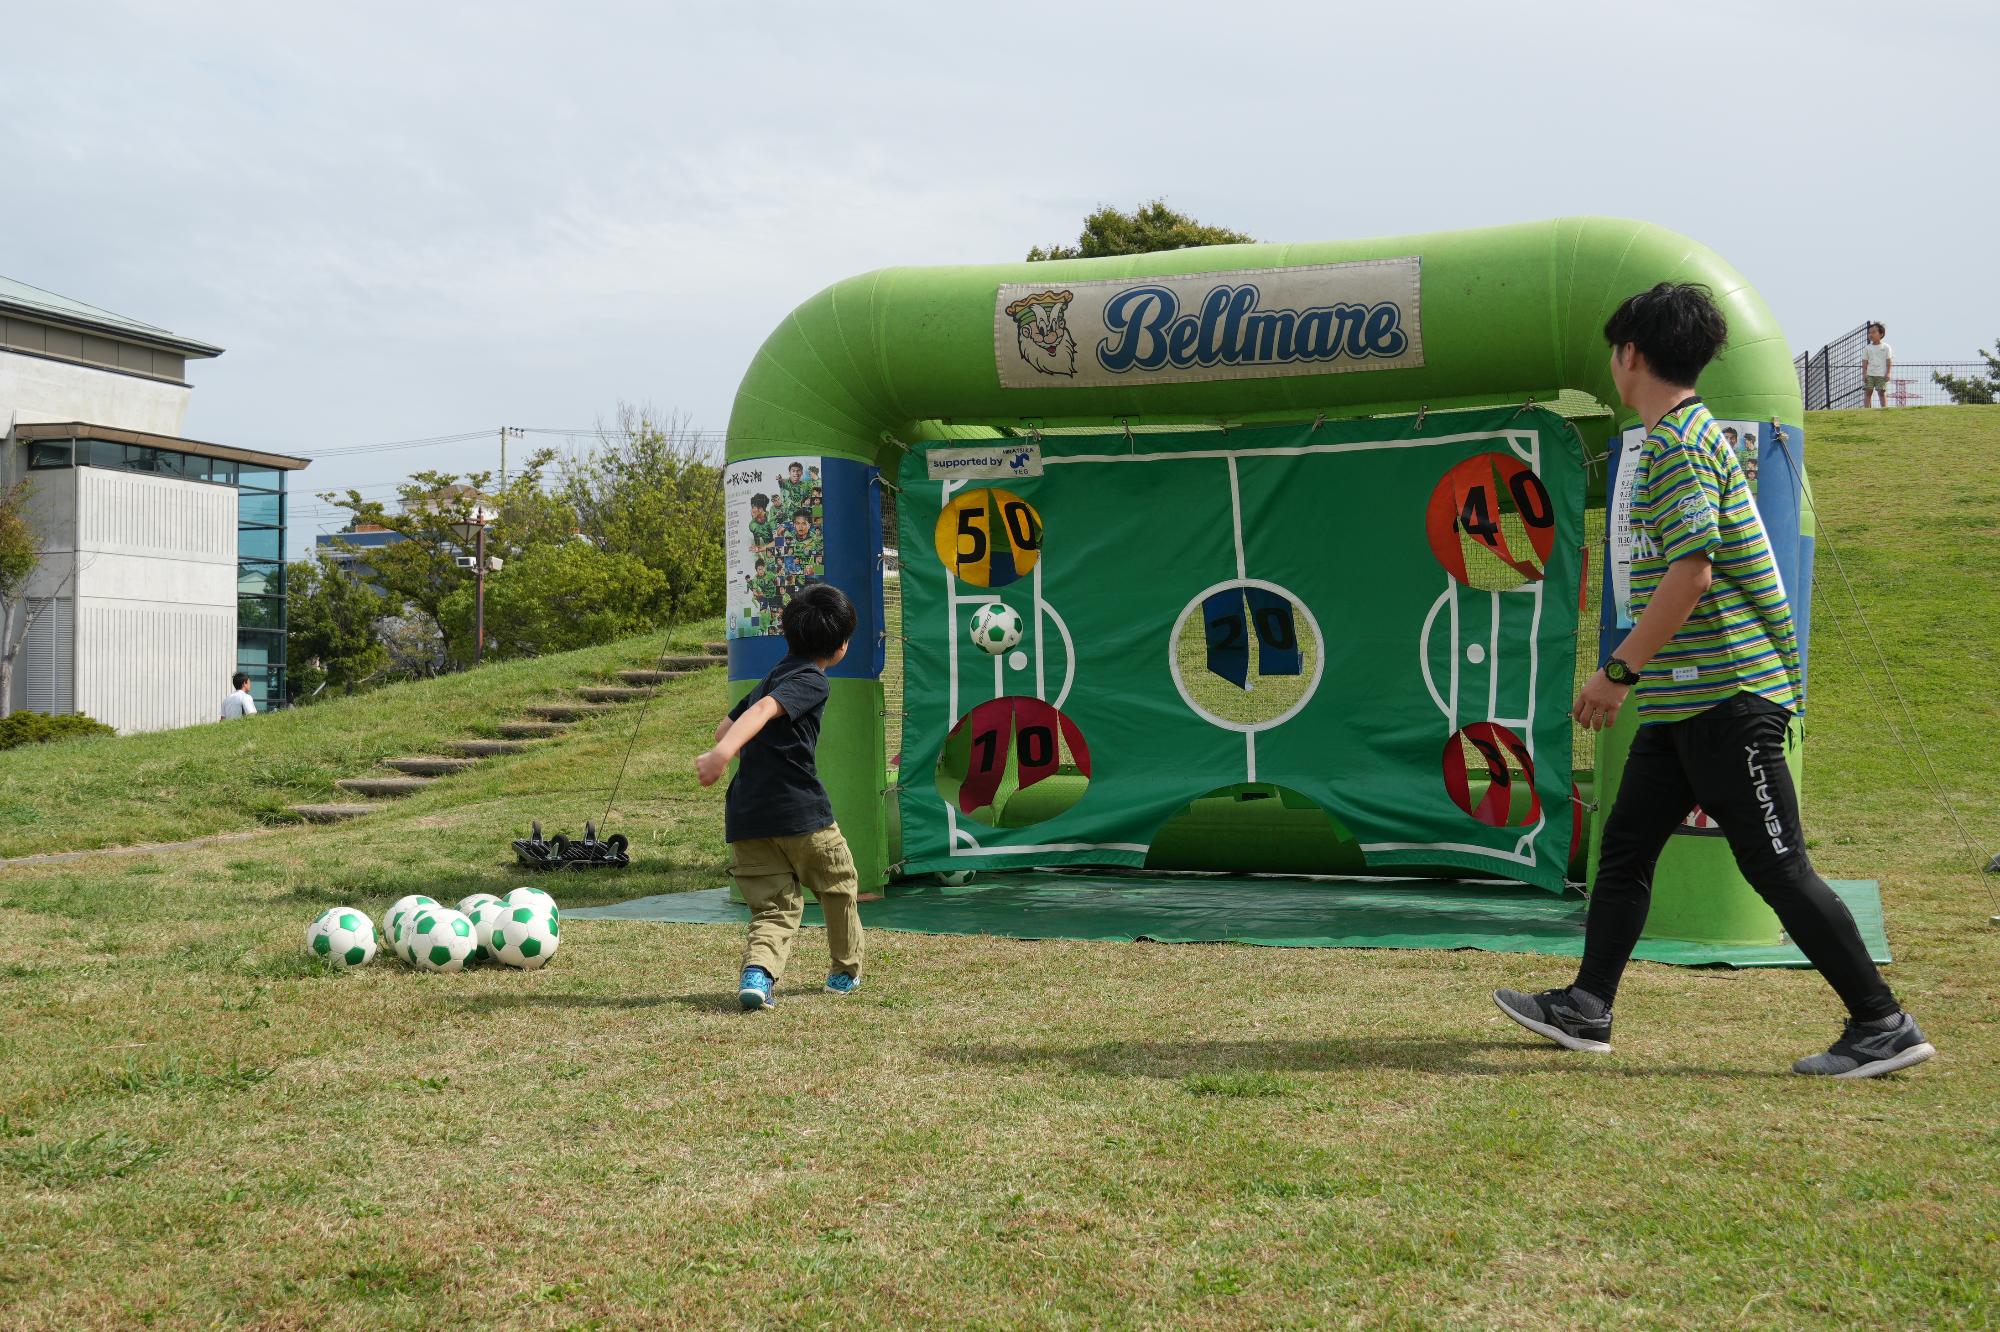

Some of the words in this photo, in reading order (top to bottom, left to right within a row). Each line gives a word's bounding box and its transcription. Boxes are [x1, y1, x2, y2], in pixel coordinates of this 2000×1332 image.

[1096, 284, 1408, 372] Bellmare
[933, 457, 987, 468] supported
[990, 457, 1003, 467] by
[957, 502, 1038, 564] 50
[1453, 470, 1555, 546] 40
[1210, 607, 1296, 651] 20
[974, 726, 1054, 773] 10
[1744, 746, 1789, 854] PENALTY
